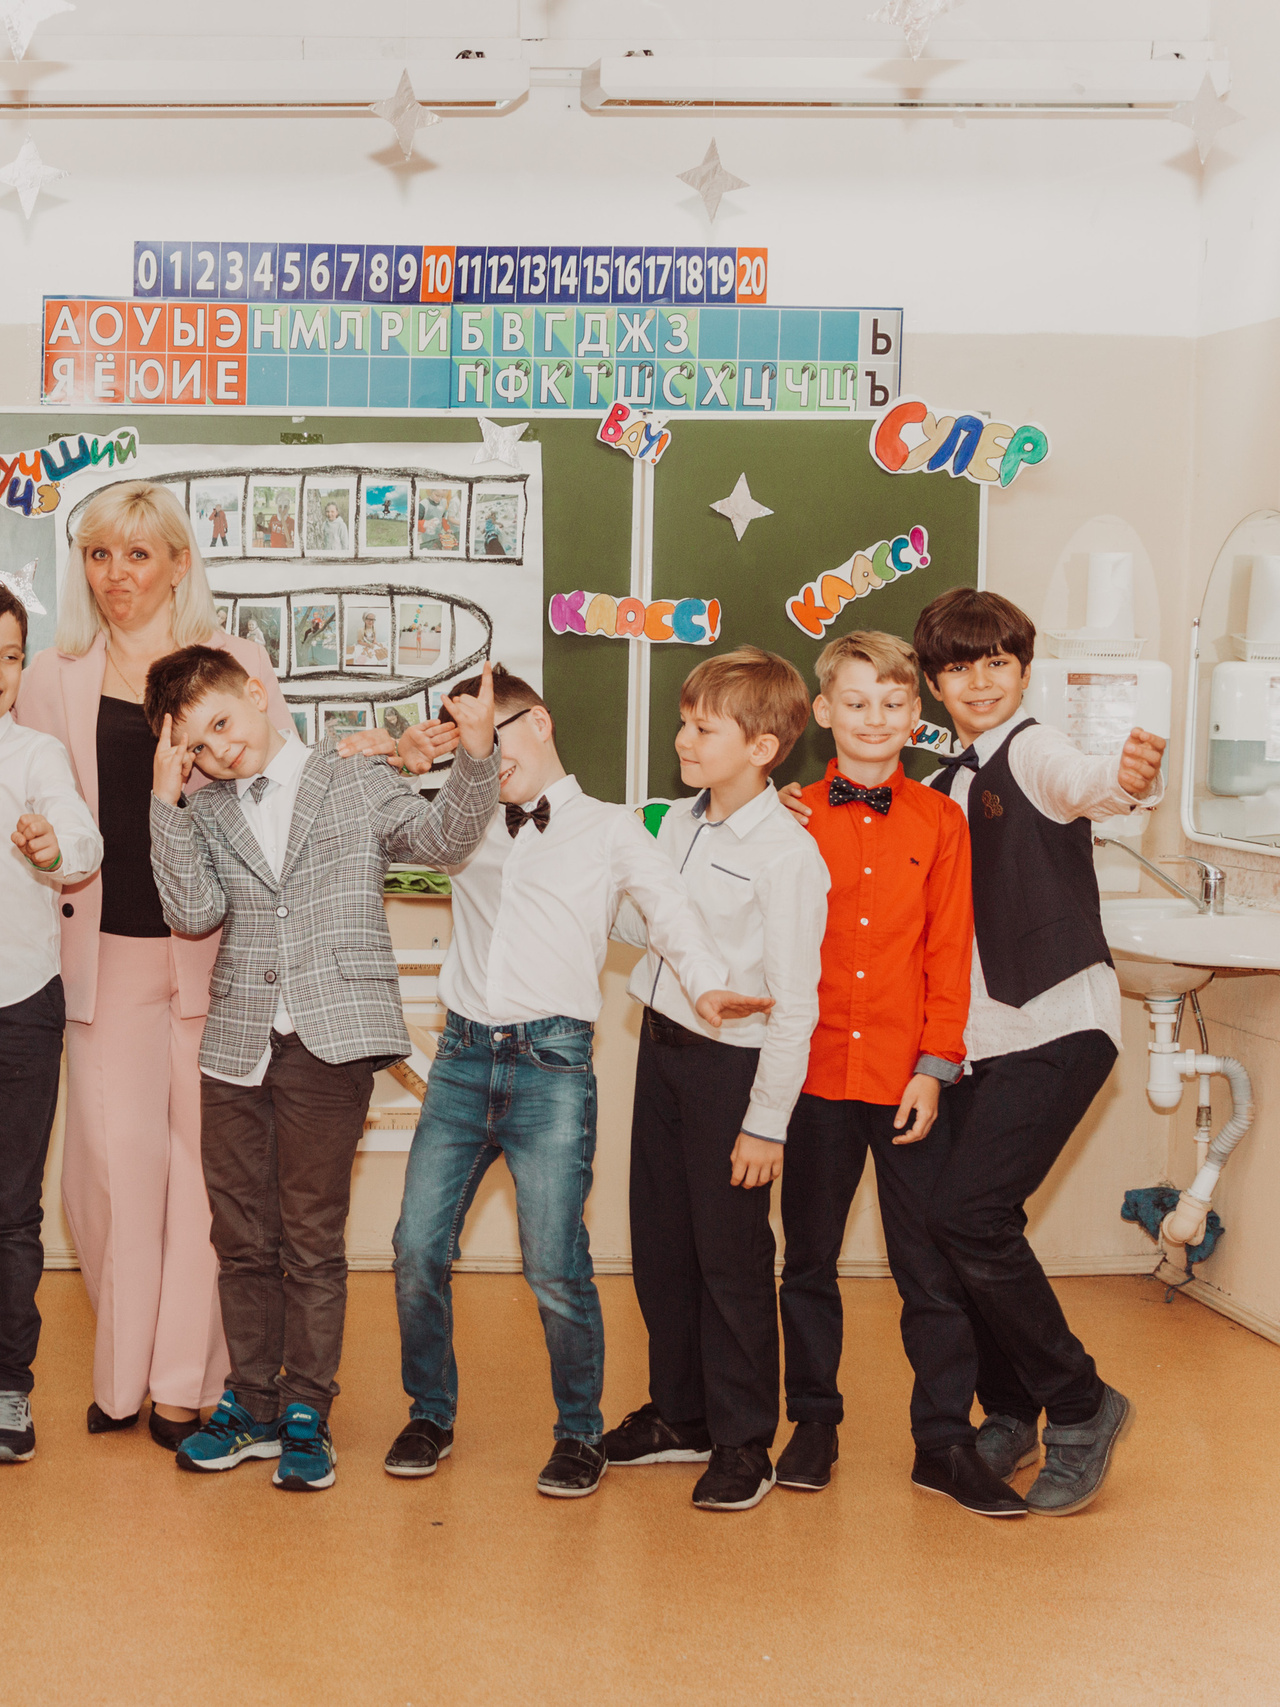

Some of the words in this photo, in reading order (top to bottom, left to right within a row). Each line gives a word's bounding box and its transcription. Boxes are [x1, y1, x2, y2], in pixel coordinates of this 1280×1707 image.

[137, 250, 157, 290] 0
[170, 251, 182, 290] 1
[196, 251, 215, 291] 2
[225, 251, 244, 291] 3
[253, 252, 274, 291] 4
[282, 252, 300, 292] 5
[310, 253, 330, 292] 6
[340, 254, 360, 293] 7
[369, 254, 388, 293] 8
[398, 254, 418, 293] 9
[425, 254, 452, 294] 10
[458, 255, 482, 294] 11
[488, 255, 515, 294] 12
[520, 255, 547, 295] 13
[551, 255, 578, 295] 14
[583, 256, 610, 295] 15
[615, 256, 641, 295] 16
[645, 256, 672, 295] 17
[676, 256, 703, 295] 18
[708, 256, 734, 296] 19
[738, 256, 766, 296] 20
[49, 306, 81, 345] А
[88, 306, 123, 346] О
[128, 308, 162, 346] У
[173, 309, 204, 347] Ы
[215, 309, 241, 348] Э
[253, 310, 281, 348] Н
[290, 311, 326, 349] М
[334, 311, 363, 350] Л
[381, 311, 404, 350] Р
[418, 310, 447, 351] Й
[461, 313, 484, 350] Б
[502, 313, 524, 351] В
[545, 314, 566, 352] Г
[578, 314, 610, 357] Д
[617, 314, 654, 353] Ж
[665, 314, 689, 353] З
[872, 319, 893, 355] Ь
[51, 359, 74, 398] Я
[94, 354, 115, 398] Ё
[130, 360, 165, 400] Ю
[172, 361, 200, 400] И
[219, 361, 238, 400] Е
[458, 365, 485, 402] П
[495, 365, 529, 403] Ф
[541, 365, 566, 404] К
[583, 366, 608, 404] Т
[617, 366, 652, 405] Ш
[662, 366, 687, 406] С
[700, 367, 731, 406] Х
[743, 368, 771, 411] Ц
[785, 368, 808, 406] Ч
[818, 368, 856, 411] Щ
[865, 371, 890, 402] Ъ
[601, 403, 669, 463] ВАУ!
[791, 527, 929, 635] КЛАСС!
[551, 590, 720, 643] КЛАСС!
